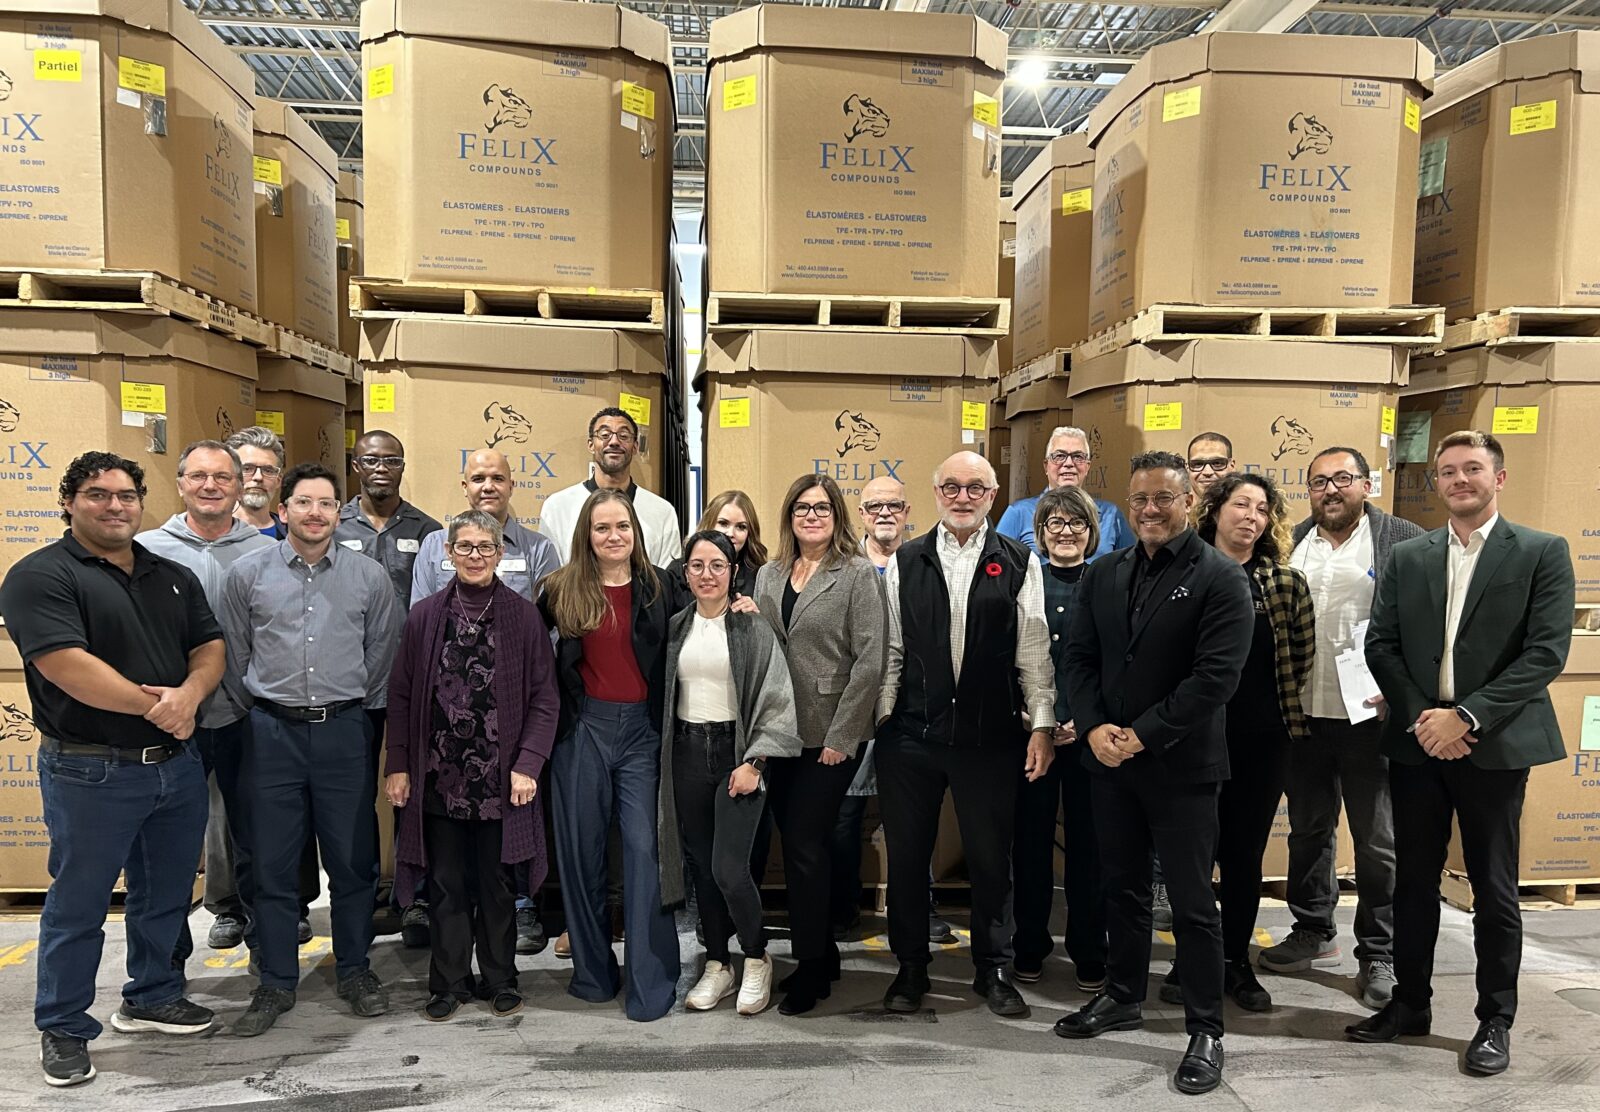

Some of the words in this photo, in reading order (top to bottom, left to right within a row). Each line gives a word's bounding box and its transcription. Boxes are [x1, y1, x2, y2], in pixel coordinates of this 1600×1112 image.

[38, 60, 78, 72] Partiel
[554, 59, 587, 68] MAXIMUM
[912, 68, 943, 76] MAXIMUM
[457, 132, 558, 166] FELIX
[819, 142, 915, 172] FELIX
[470, 164, 542, 176] COMPOUNDS
[206, 154, 240, 200] FELIX
[831, 174, 900, 184] COMPOUNDS
[1258, 164, 1351, 192] FELIX
[1270, 194, 1336, 202] COMPOUNDS
[515, 206, 570, 216] ELASTOMERS
[875, 214, 926, 222] ELASTOMERS
[1398, 470, 1435, 492] ELIX
